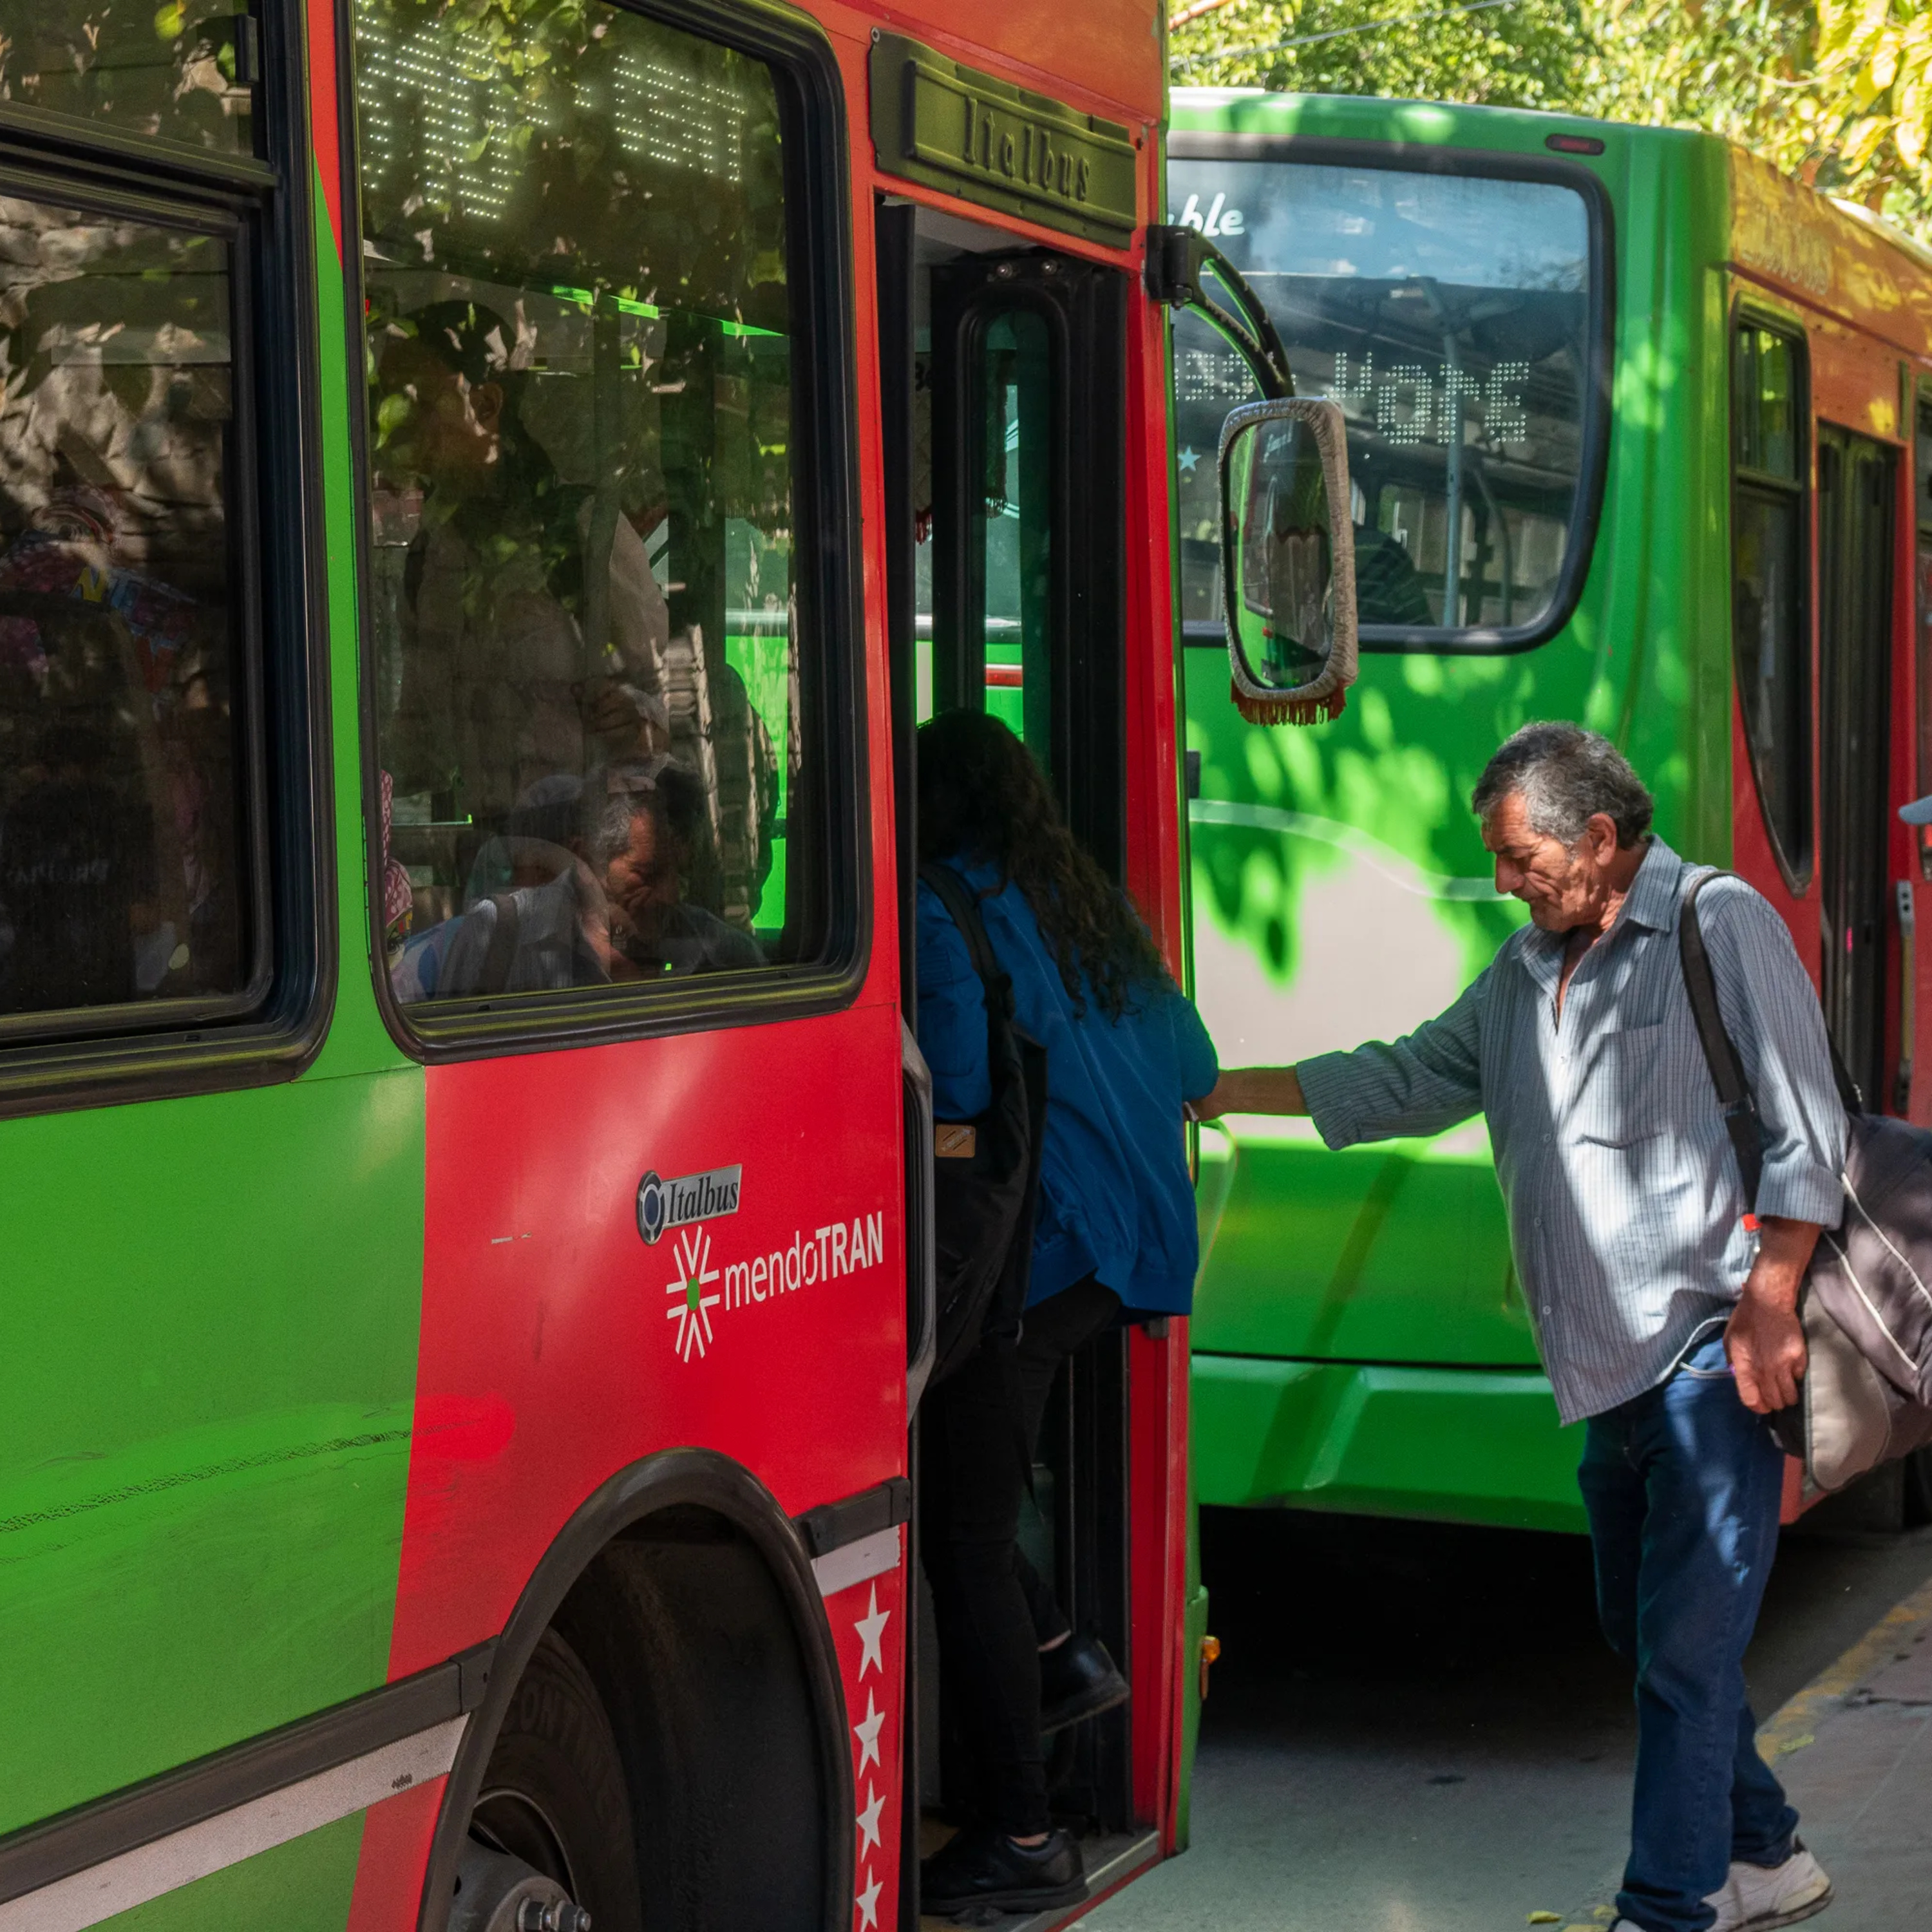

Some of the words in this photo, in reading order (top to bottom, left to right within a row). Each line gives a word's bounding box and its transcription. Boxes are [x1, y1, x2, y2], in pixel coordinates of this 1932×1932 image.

[964, 97, 1090, 202] Italbus
[1167, 192, 1245, 236] ble
[668, 1177, 739, 1223] Italbus
[725, 1211, 883, 1311] mendoTRAN
